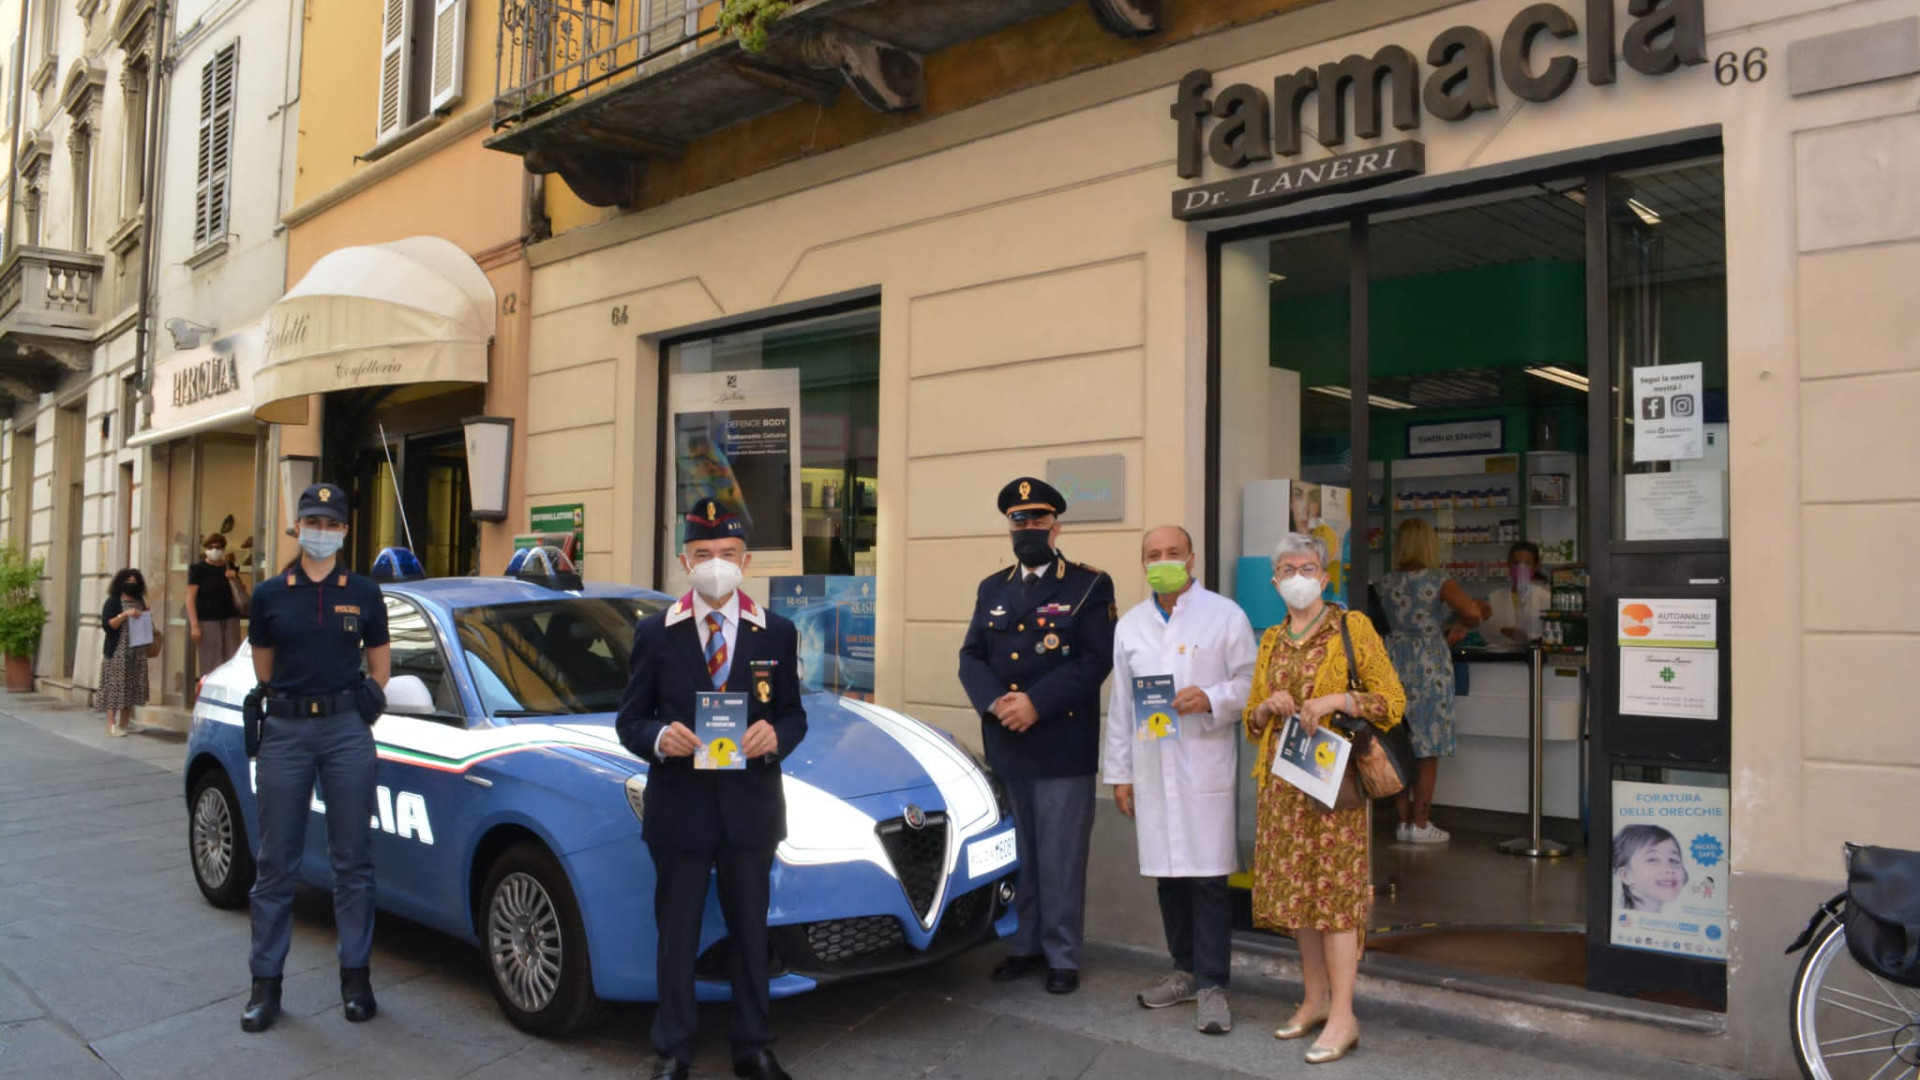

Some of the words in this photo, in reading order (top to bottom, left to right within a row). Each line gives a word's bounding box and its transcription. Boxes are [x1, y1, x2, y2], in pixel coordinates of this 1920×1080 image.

[1714, 47, 1768, 86] 66
[1170, 0, 1709, 179] farmacia
[1183, 190, 1230, 211] Dr.
[1247, 147, 1399, 197] LANERI
[611, 304, 629, 326] 64
[1640, 374, 1660, 384] Segui
[1662, 374, 1669, 382] le
[1670, 373, 1695, 381] nostre
[725, 419, 761, 429] DEFENCE
[763, 418, 787, 427] BODY
[1657, 612, 1711, 620] AUTOANALISI
[1635, 793, 1702, 803] FORATURA
[1619, 807, 1655, 817] DELLE
[1658, 807, 1723, 817] ORECCHIE
